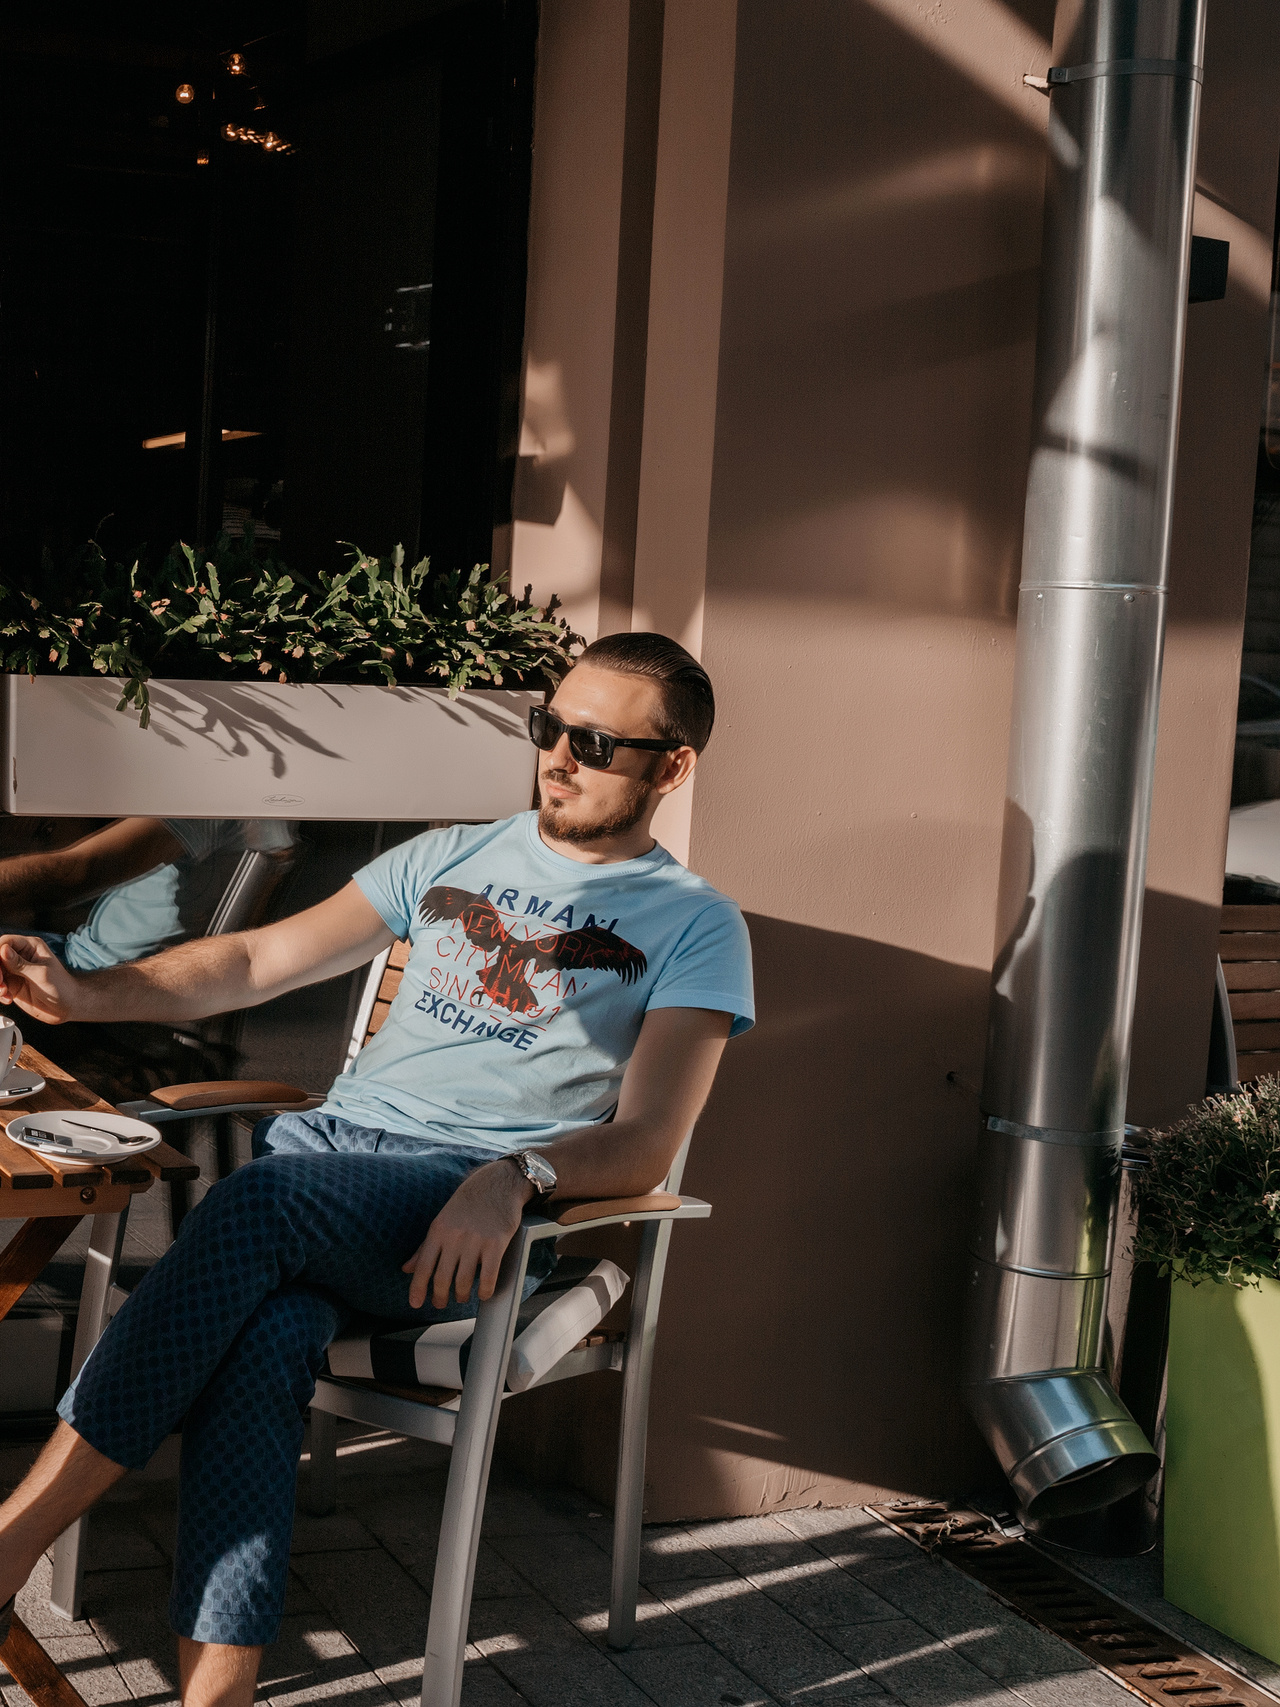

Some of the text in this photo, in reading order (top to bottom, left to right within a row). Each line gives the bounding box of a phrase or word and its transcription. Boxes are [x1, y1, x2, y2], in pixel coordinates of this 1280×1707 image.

[477, 883, 619, 933] ARMANI
[436, 935, 587, 999] CITY MILAN
[452, 910, 605, 971] NEW YORK
[414, 989, 539, 1051] EXCHANGE
